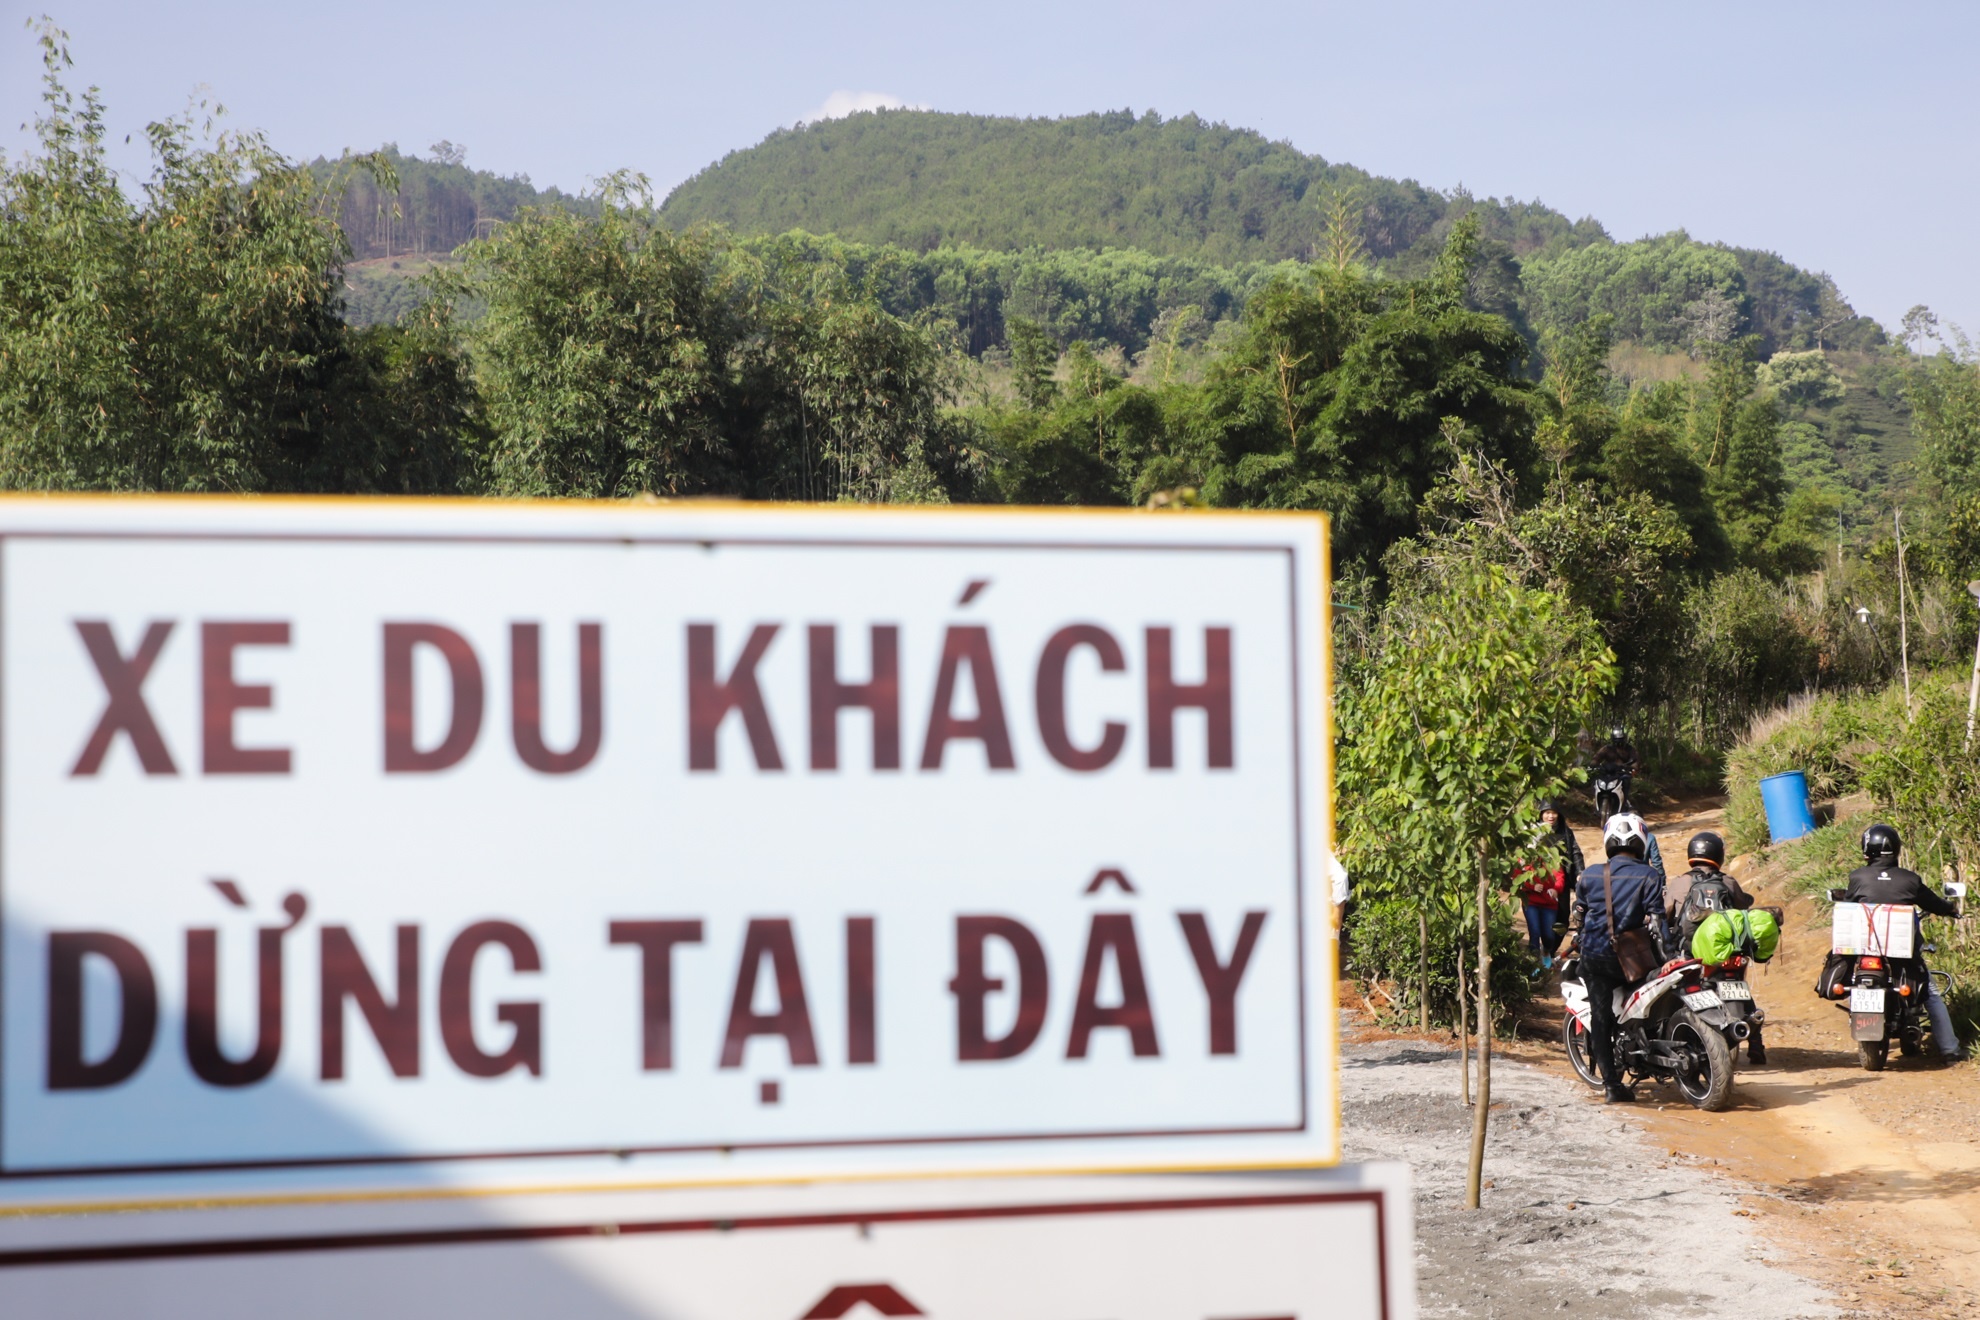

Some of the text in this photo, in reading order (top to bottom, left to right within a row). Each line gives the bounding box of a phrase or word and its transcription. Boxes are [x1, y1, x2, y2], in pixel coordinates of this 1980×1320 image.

[70, 580, 1235, 777] XE DU KHÁCH
[43, 867, 1269, 1105] DỪNG TẠI ĐÂY
